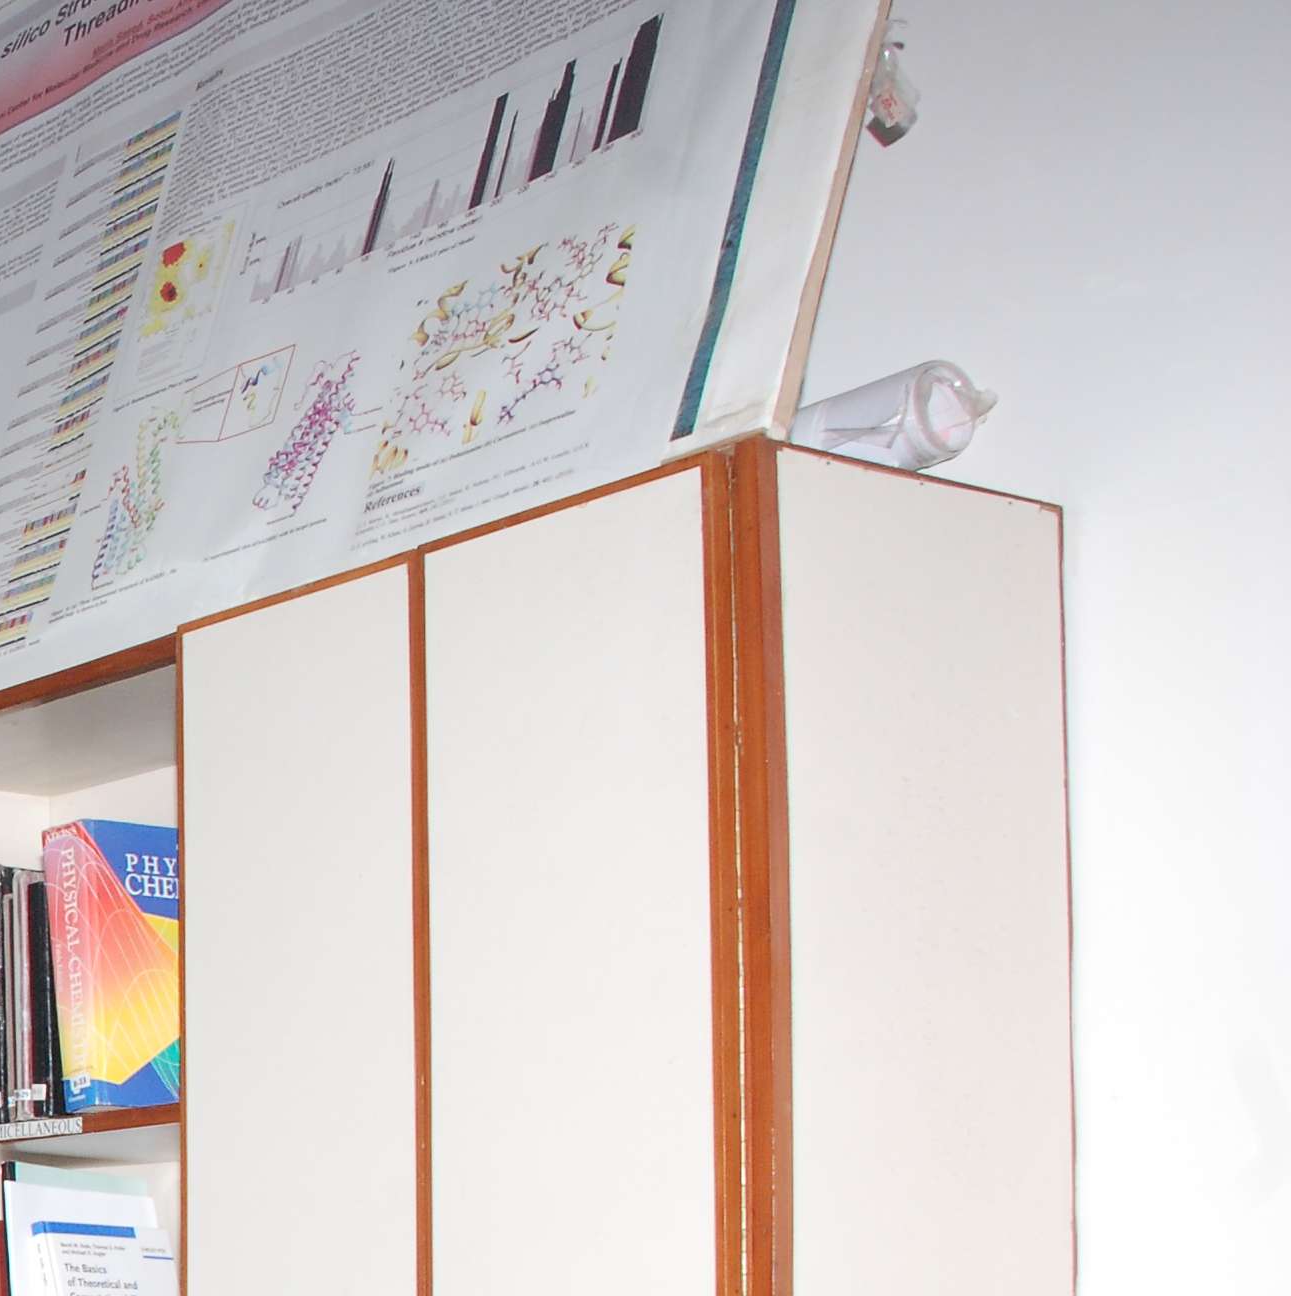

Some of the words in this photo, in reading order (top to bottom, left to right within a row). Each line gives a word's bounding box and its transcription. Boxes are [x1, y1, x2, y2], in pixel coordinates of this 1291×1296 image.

[0, 18, 51, 60] silico
[364, 484, 421, 513] References
[124, 853, 177, 876] PHY
[124, 873, 178, 898] CHE
[60, 846, 82, 953] PHYSICAL
[64, 1263, 80, 1273] The
[81, 1264, 107, 1275] Basics
[67, 1276, 76, 1287] of
[77, 1277, 121, 1290] Theoretical
[123, 1280, 138, 1290] and
